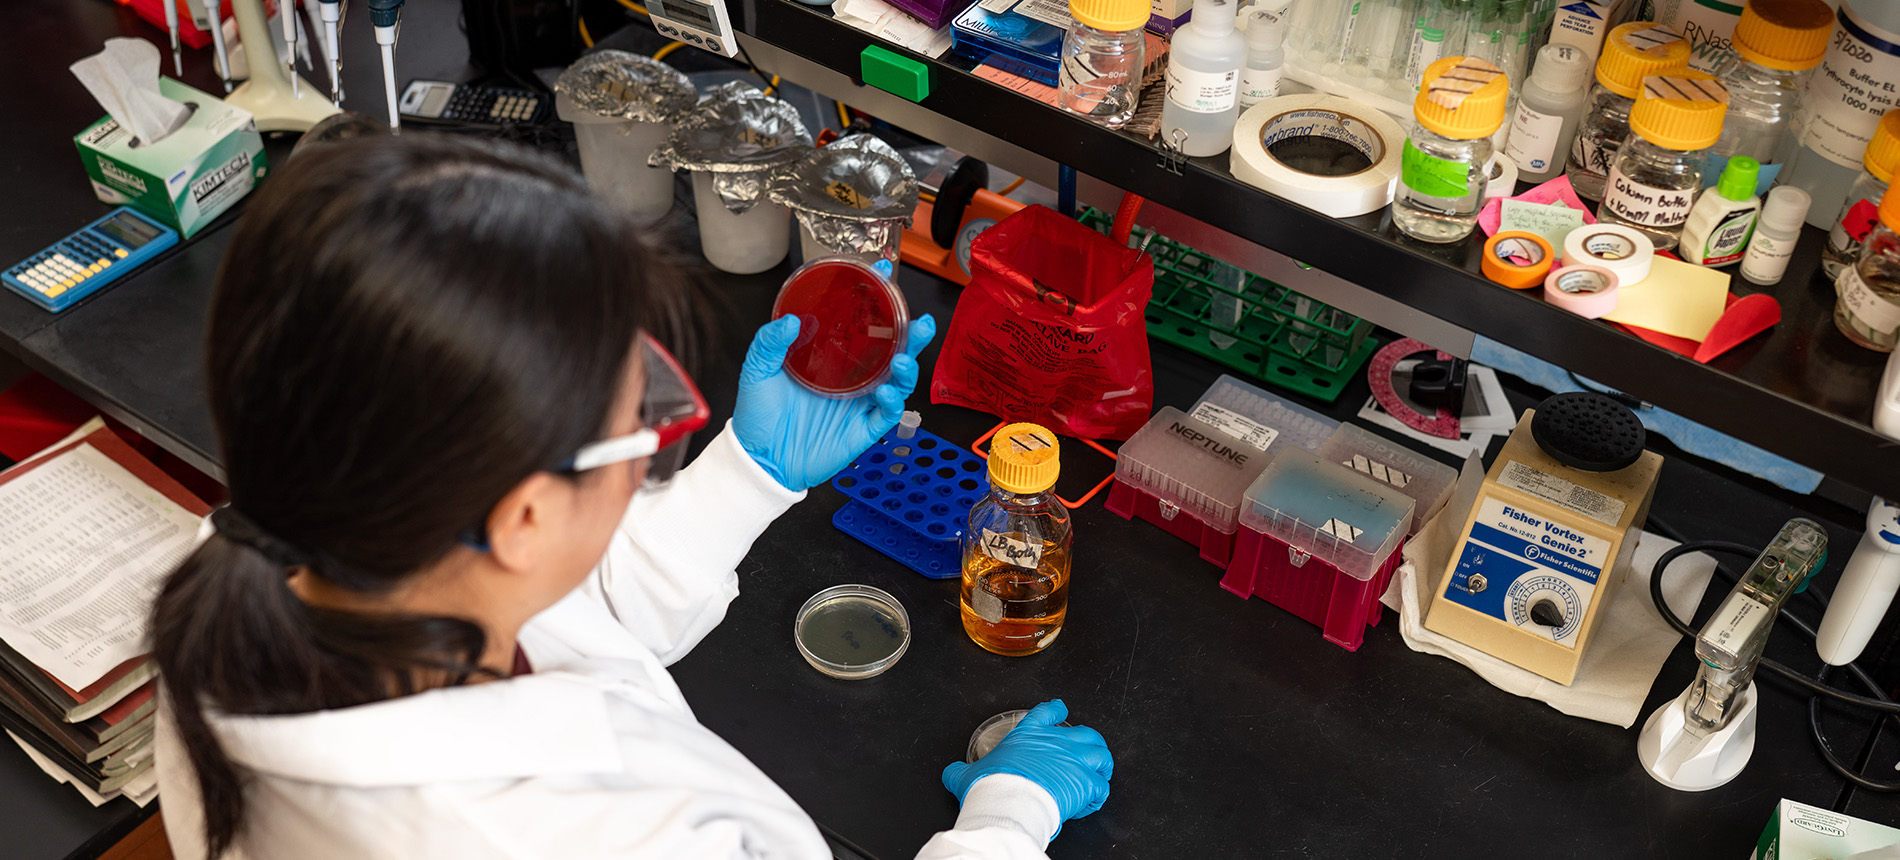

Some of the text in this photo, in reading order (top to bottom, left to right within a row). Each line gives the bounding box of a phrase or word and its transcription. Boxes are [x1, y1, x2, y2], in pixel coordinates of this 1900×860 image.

[1568, 15, 1591, 24] ADVANCE
[1560, 23, 1594, 35] PERFORATION
[1834, 30, 1873, 63] 5/2020
[1822, 61, 1864, 96] Erythrocyte
[1867, 91, 1892, 105] lysis
[1849, 68, 1896, 93] Buffer EL
[1842, 94, 1885, 117] 1000 ml
[193, 152, 249, 198] KIMTECH
[1444, 208, 1456, 216] 40
[1720, 223, 1748, 238] Liquid
[1714, 235, 1741, 249] Paper
[1169, 421, 1249, 466] NEPTUNE
[1129, 468, 1142, 482] 20
[1502, 506, 1585, 545] Fisher Vortex
[989, 535, 1007, 549] LB
[1540, 552, 1563, 567] Fisher
[1563, 561, 1597, 579] Scientific
[1036, 594, 1048, 602] 300
[1034, 629, 1046, 638] 100
